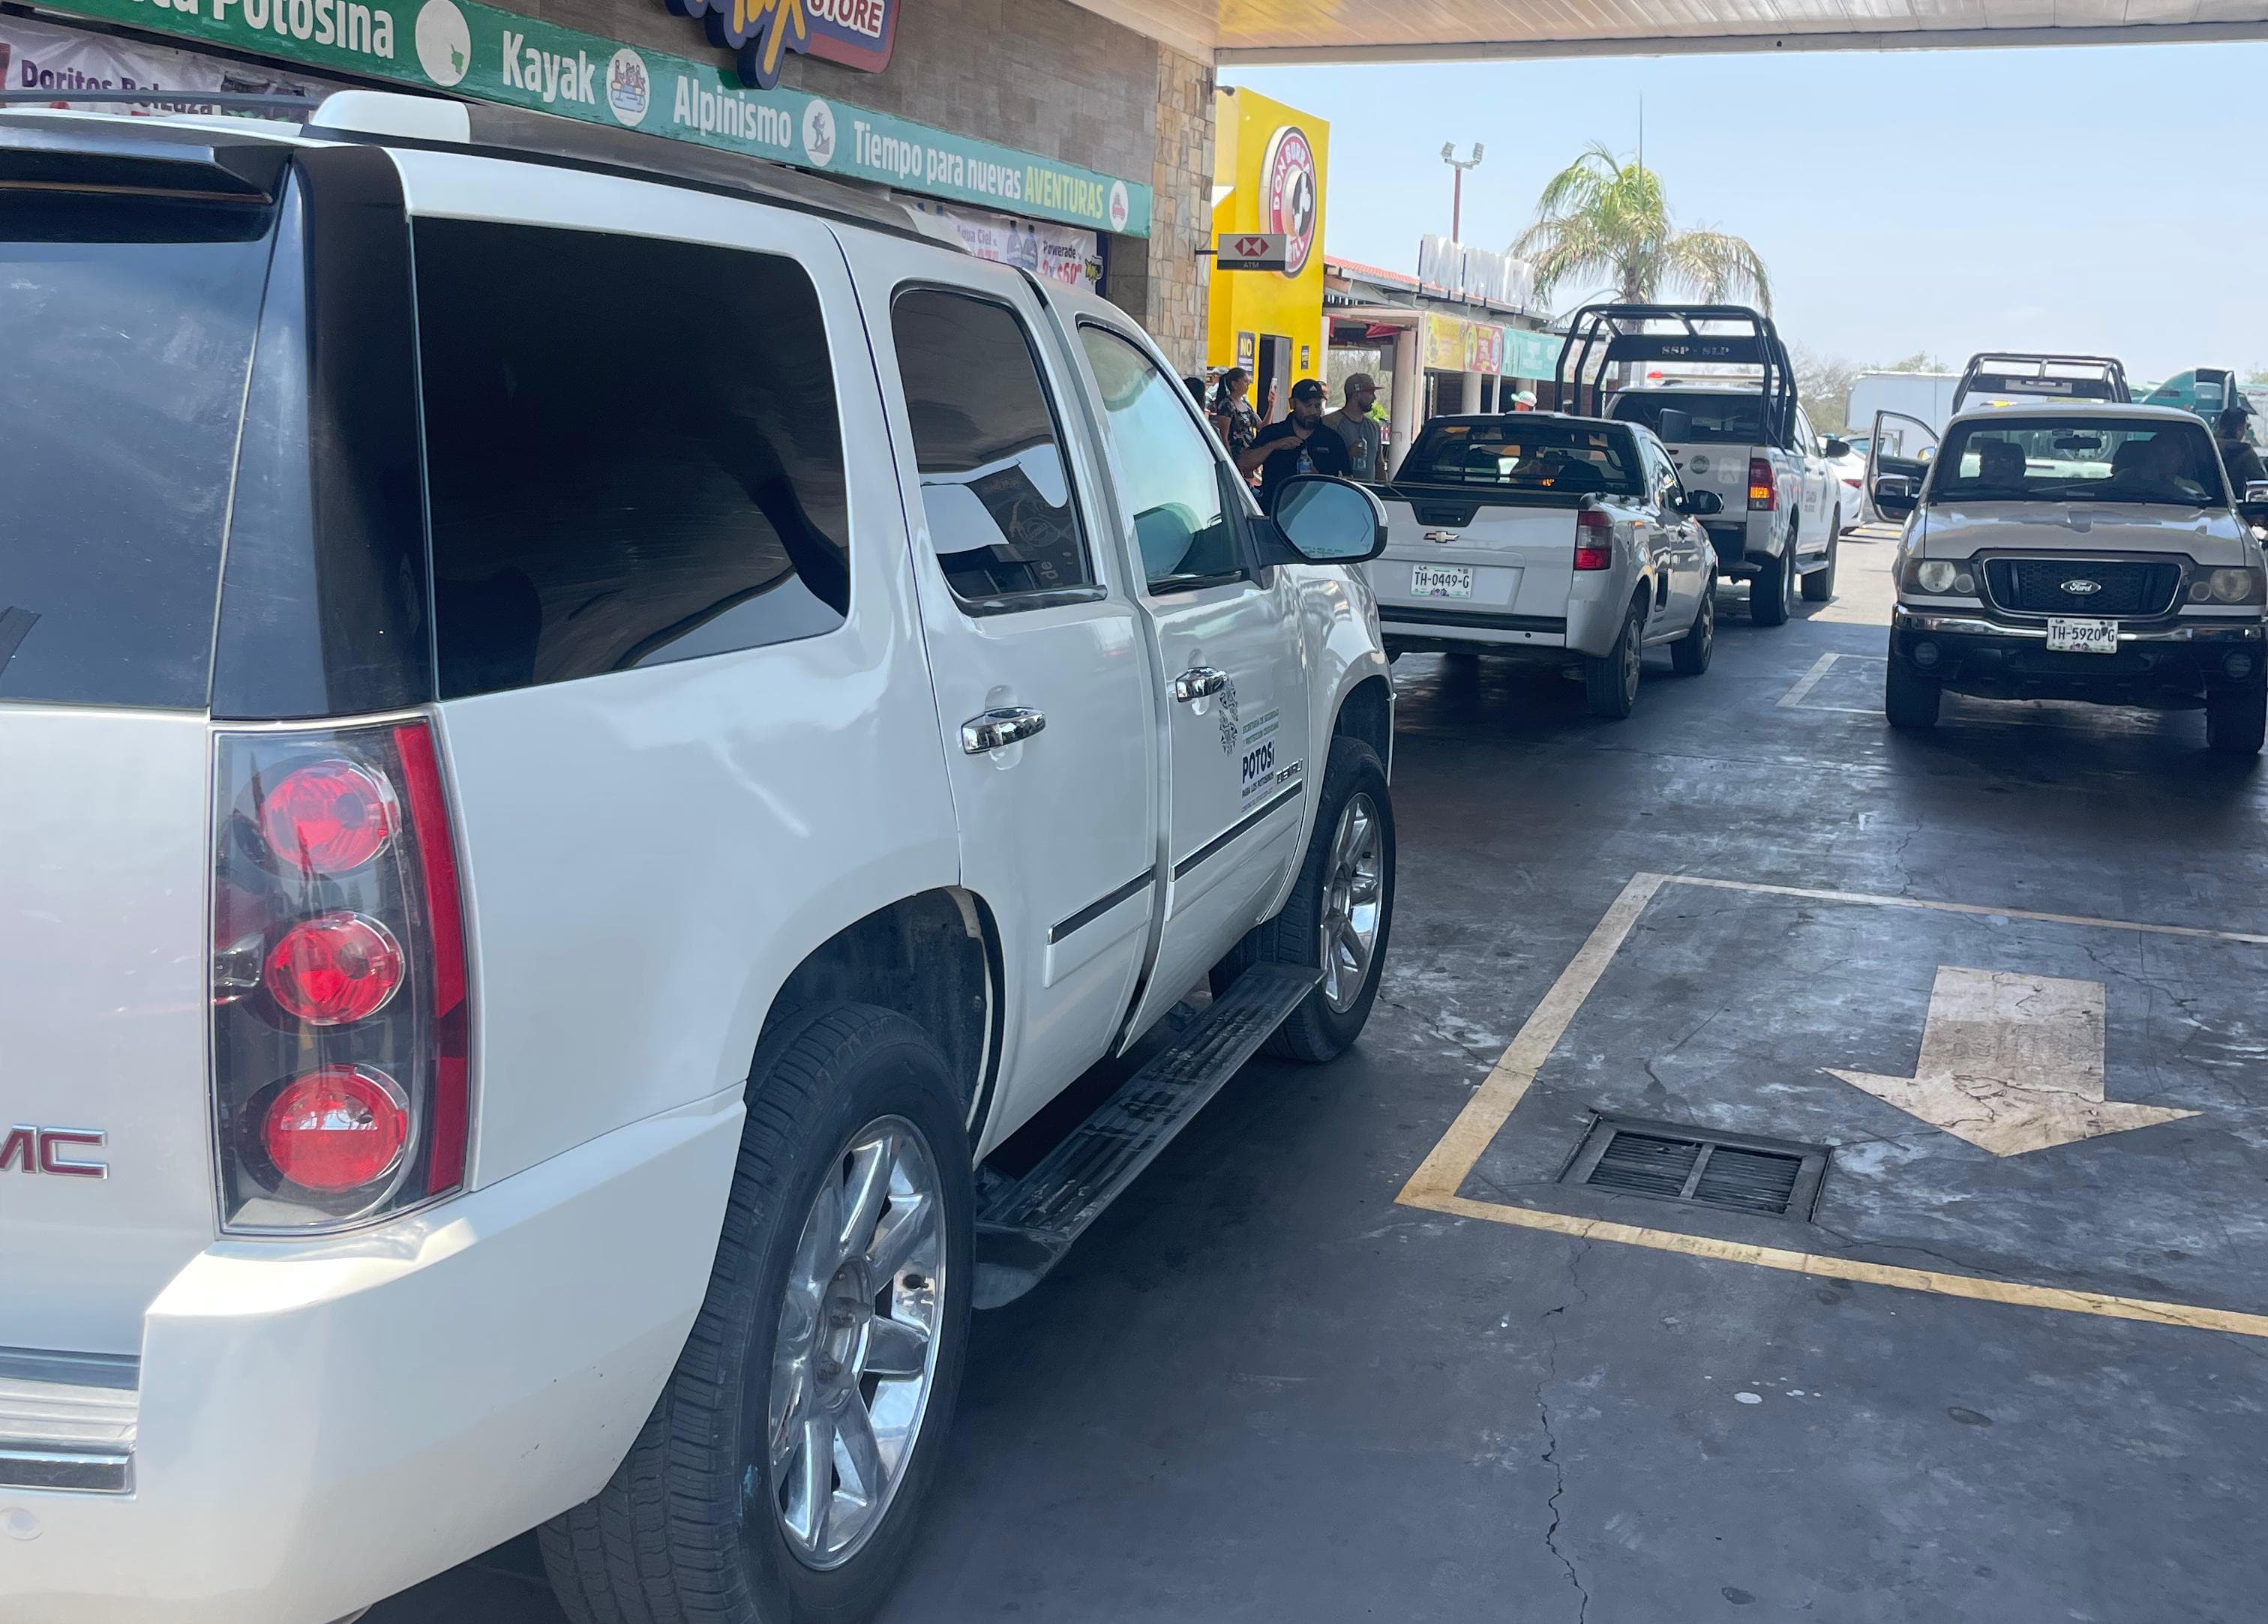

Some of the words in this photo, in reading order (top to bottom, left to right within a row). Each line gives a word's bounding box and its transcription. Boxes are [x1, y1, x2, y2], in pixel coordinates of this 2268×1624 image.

[21, 59, 112, 91] Doritos
[502, 30, 597, 104] Kayak
[674, 75, 792, 148] Alpinismo
[854, 121, 922, 181] Tiempo
[926, 149, 964, 187] para
[968, 162, 1022, 201] nuevas
[1024, 166, 1104, 220] AVENTURAS
[1043, 240, 1076, 259] Powerade
[1240, 338, 1252, 357] NO
[1661, 346, 1689, 355] SSP
[1414, 571, 1470, 589] TH-0449-G
[2069, 581, 2093, 592] Ford
[2051, 625, 2115, 643] TH-5920G
